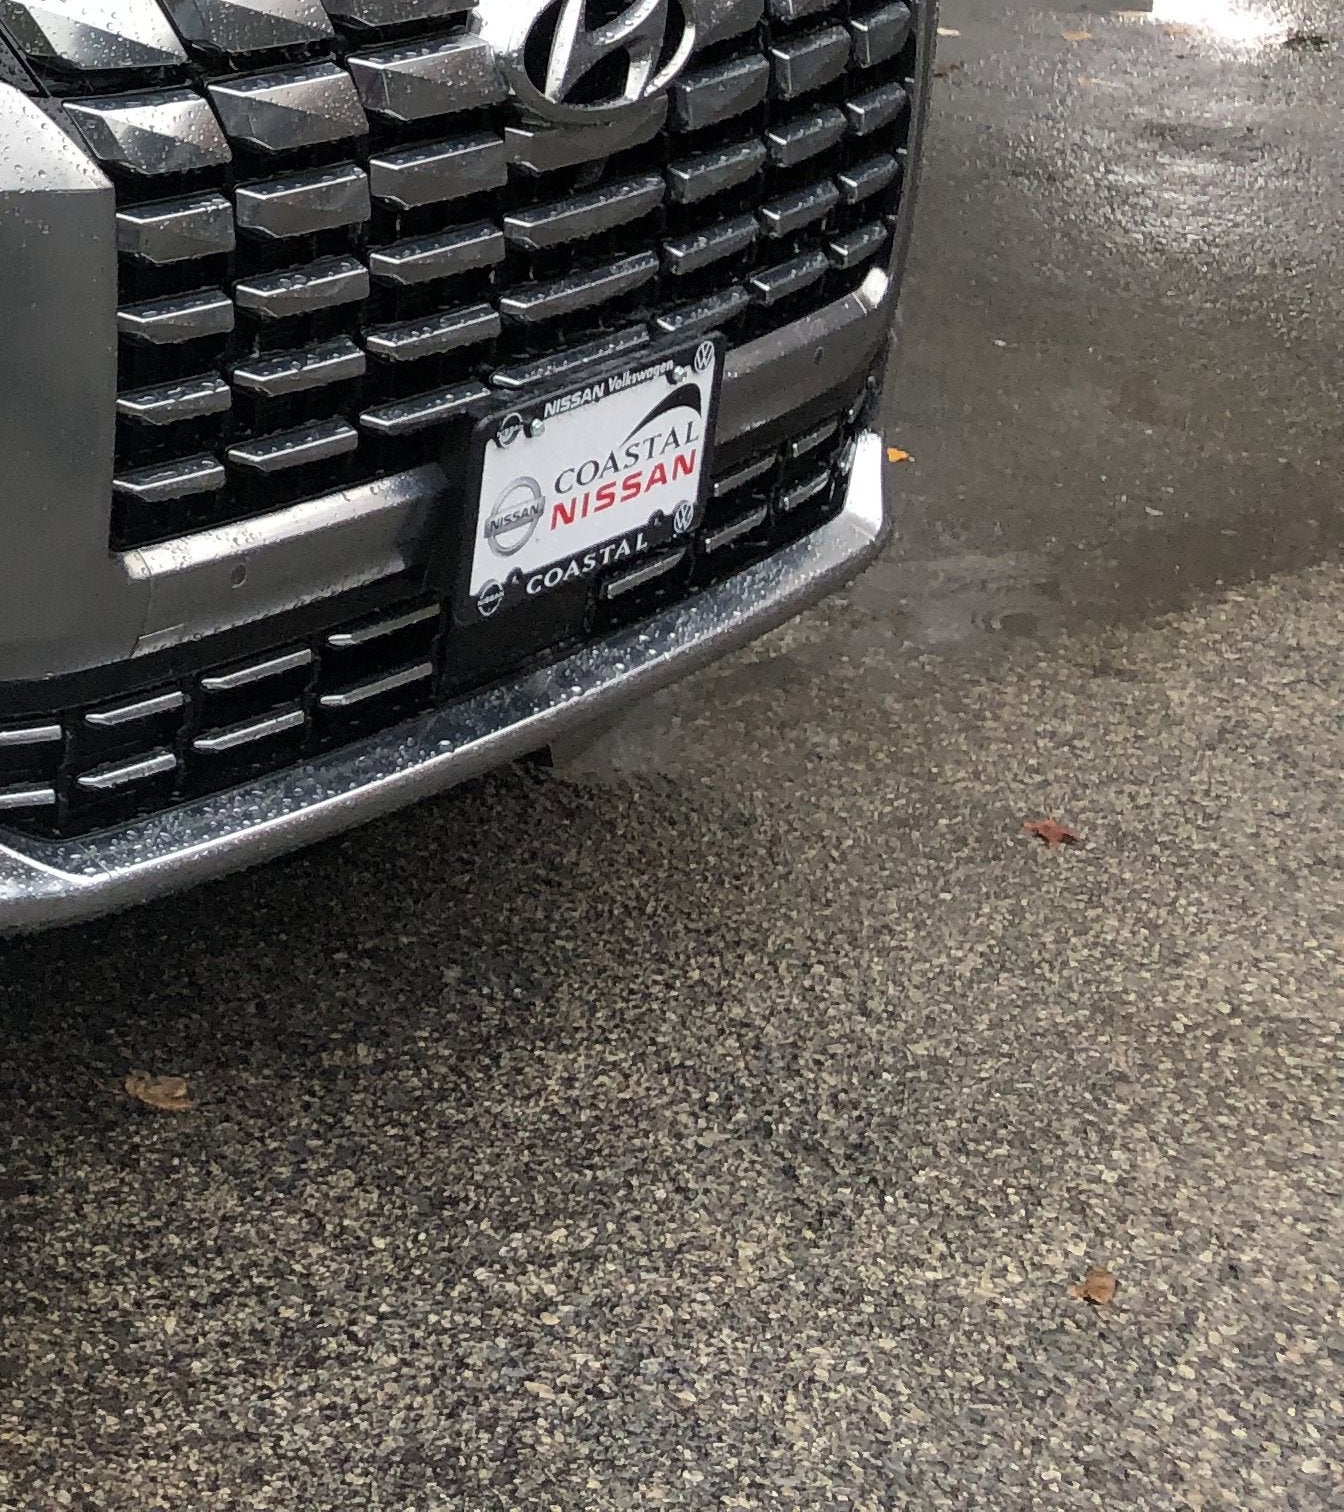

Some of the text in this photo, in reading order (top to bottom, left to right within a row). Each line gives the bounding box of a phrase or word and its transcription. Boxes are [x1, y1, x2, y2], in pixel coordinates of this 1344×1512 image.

[543, 360, 674, 418] NISSAN Volkswagen
[554, 421, 701, 495] COASTAL
[489, 504, 540, 531] NISSAN
[550, 449, 696, 531] NISSAN
[526, 533, 648, 595] COASTAL
